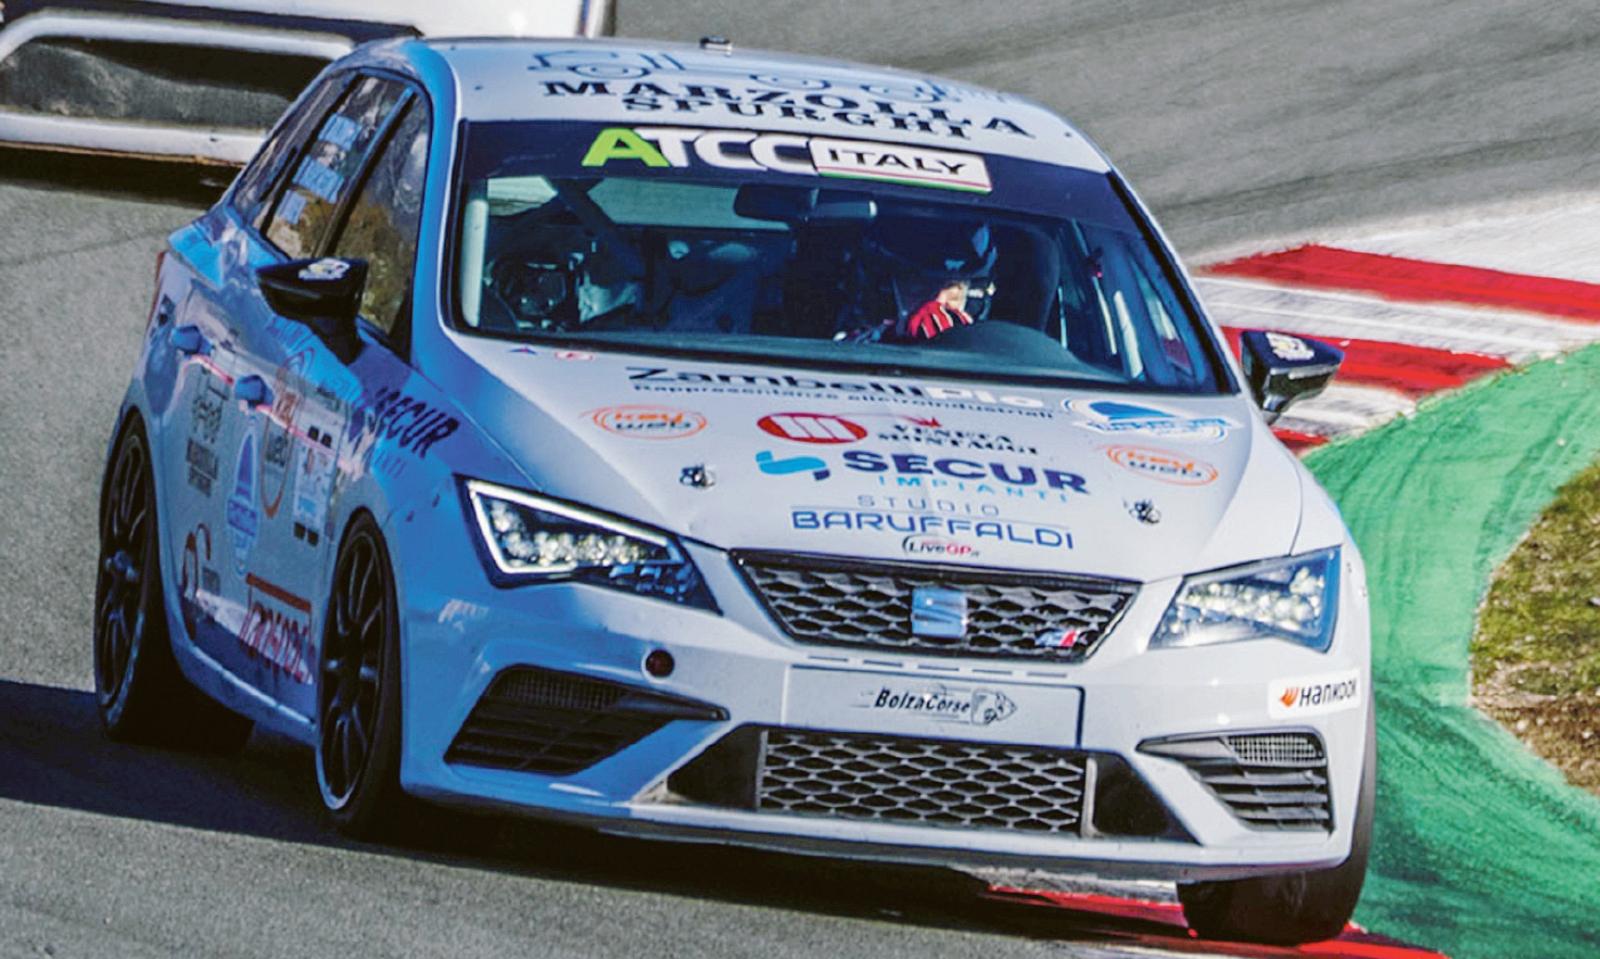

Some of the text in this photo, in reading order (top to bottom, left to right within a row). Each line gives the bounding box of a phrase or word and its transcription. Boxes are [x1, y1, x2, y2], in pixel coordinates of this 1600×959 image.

[543, 80, 1037, 139] MARZOLLA
[621, 95, 972, 141] SPURGHI
[581, 127, 969, 176] ATCC ITALY
[633, 383, 839, 400] Rappresentanze
[842, 450, 1090, 494] SECUR
[878, 475, 1069, 502] IMPIANTI
[857, 494, 999, 516] STUDIO
[791, 510, 1074, 550] BARUFFALDI
[873, 687, 971, 713] BolzaCorse
